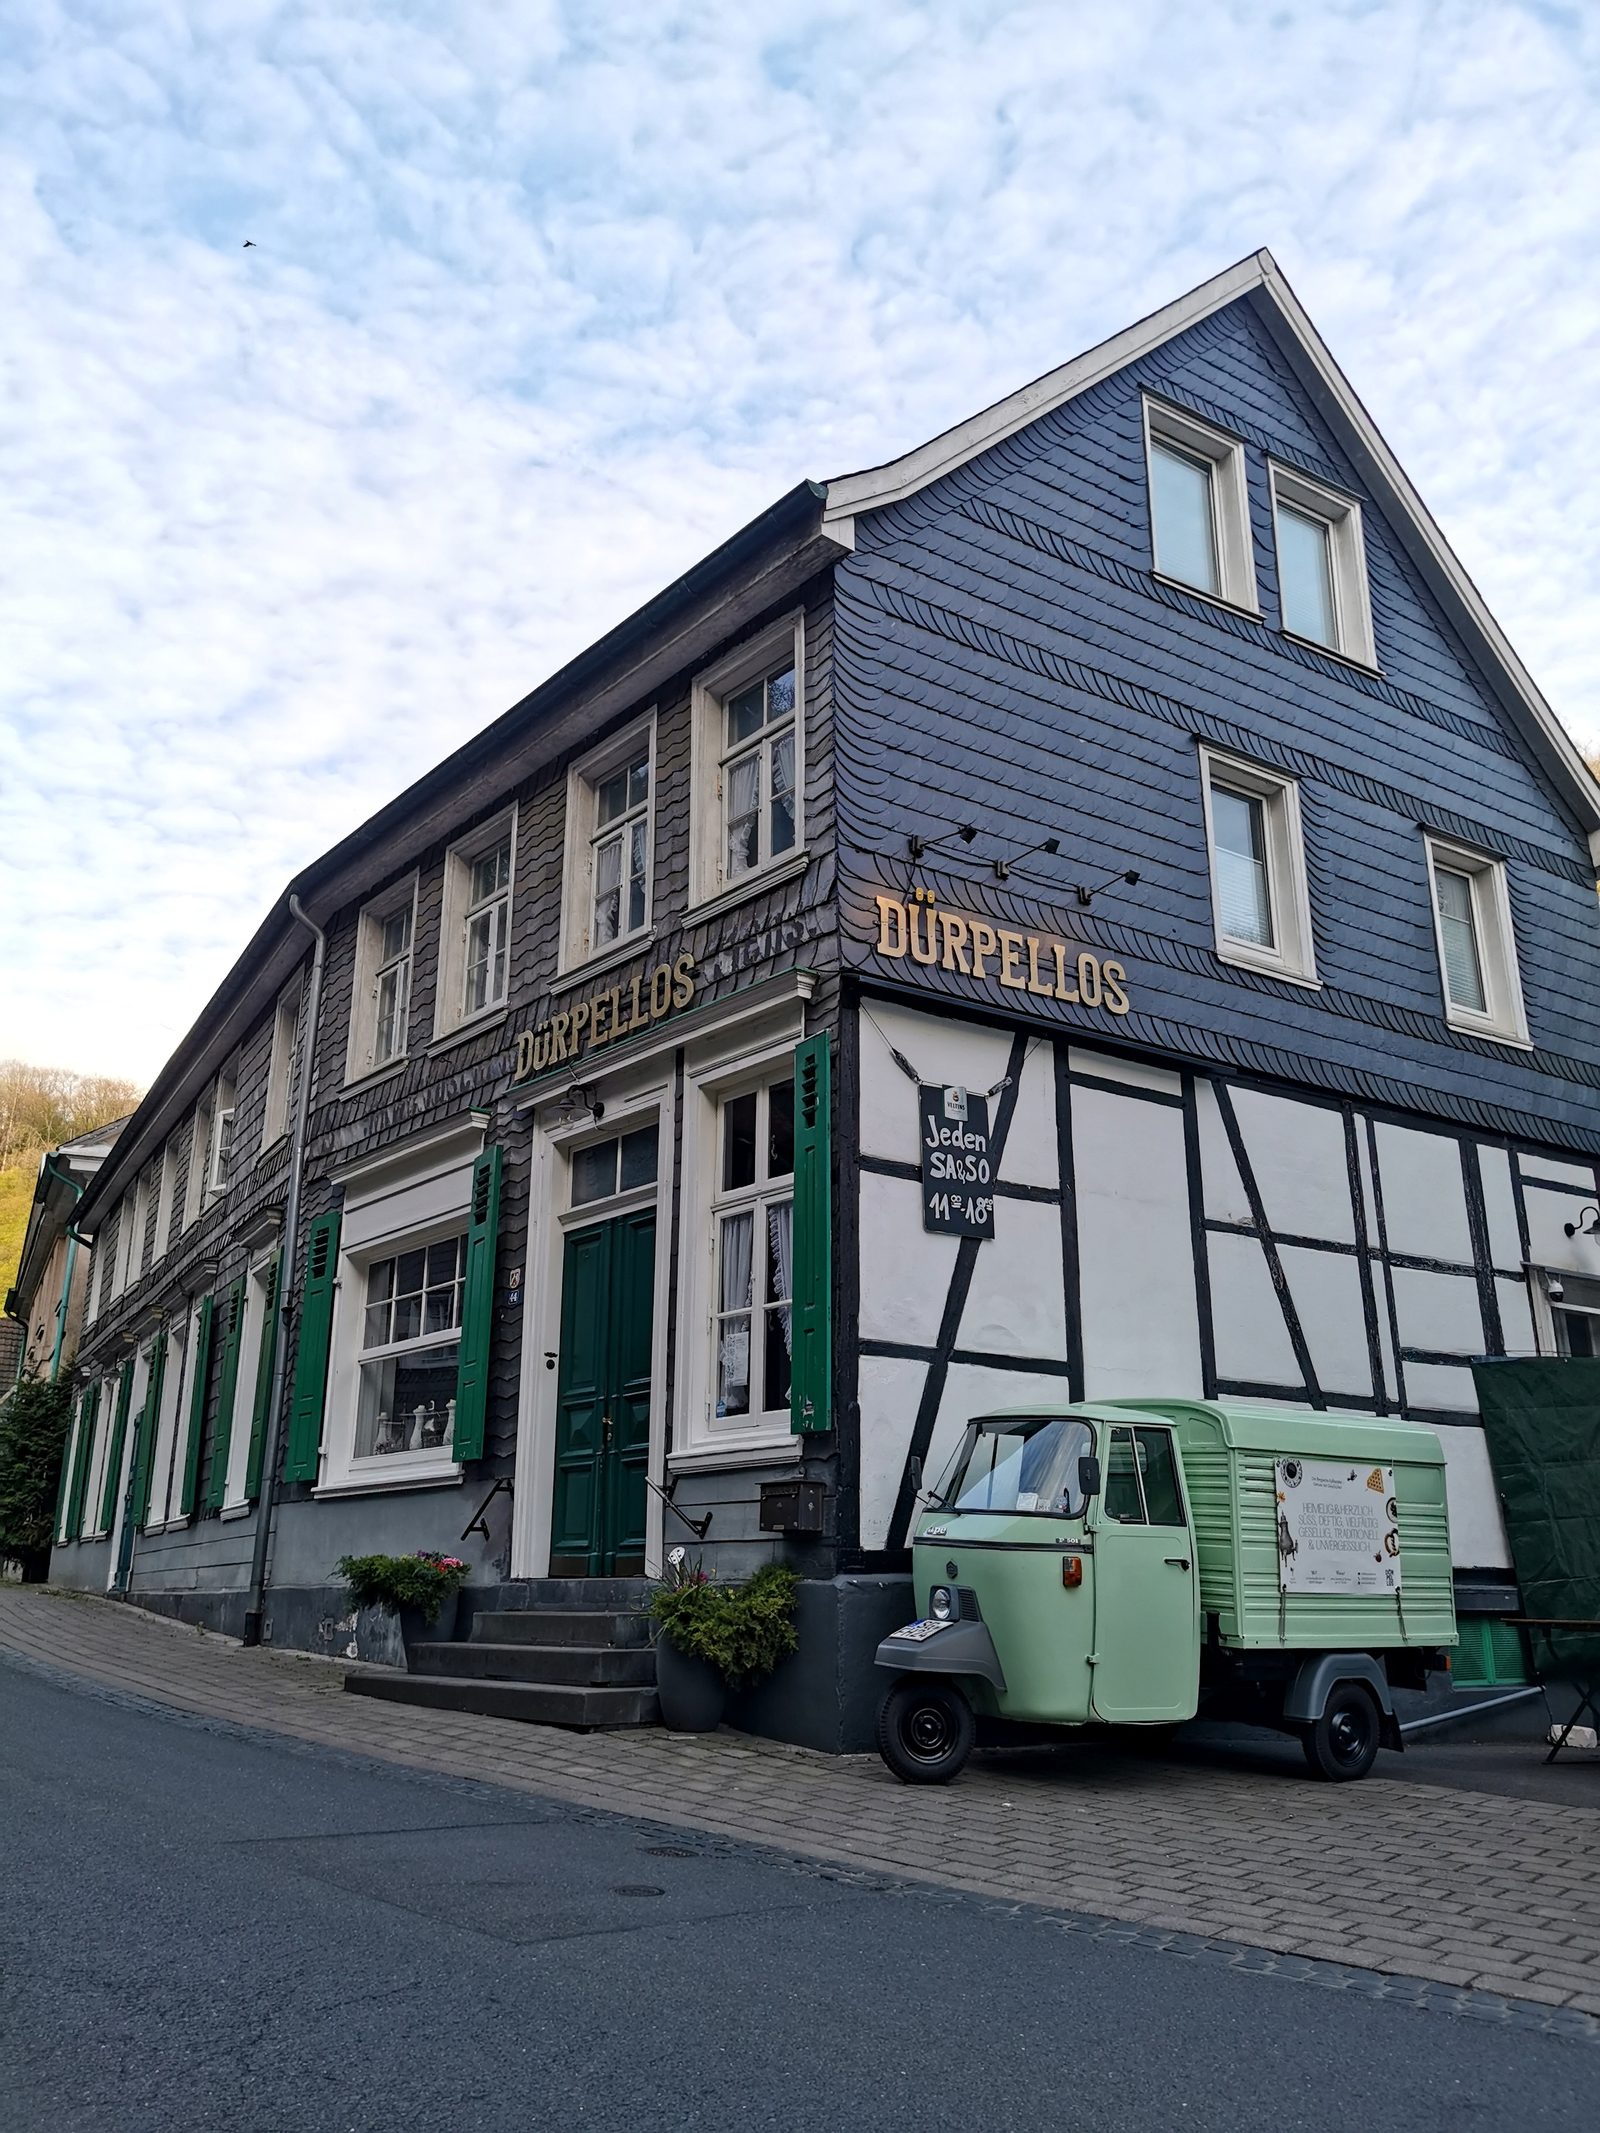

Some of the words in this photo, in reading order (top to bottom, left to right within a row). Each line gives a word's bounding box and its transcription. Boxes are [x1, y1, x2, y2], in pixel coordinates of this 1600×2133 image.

[876, 887, 1130, 1015] DÜRPELLOS
[925, 1114, 987, 1153] Jeden
[509, 1291, 518, 1303] 44
